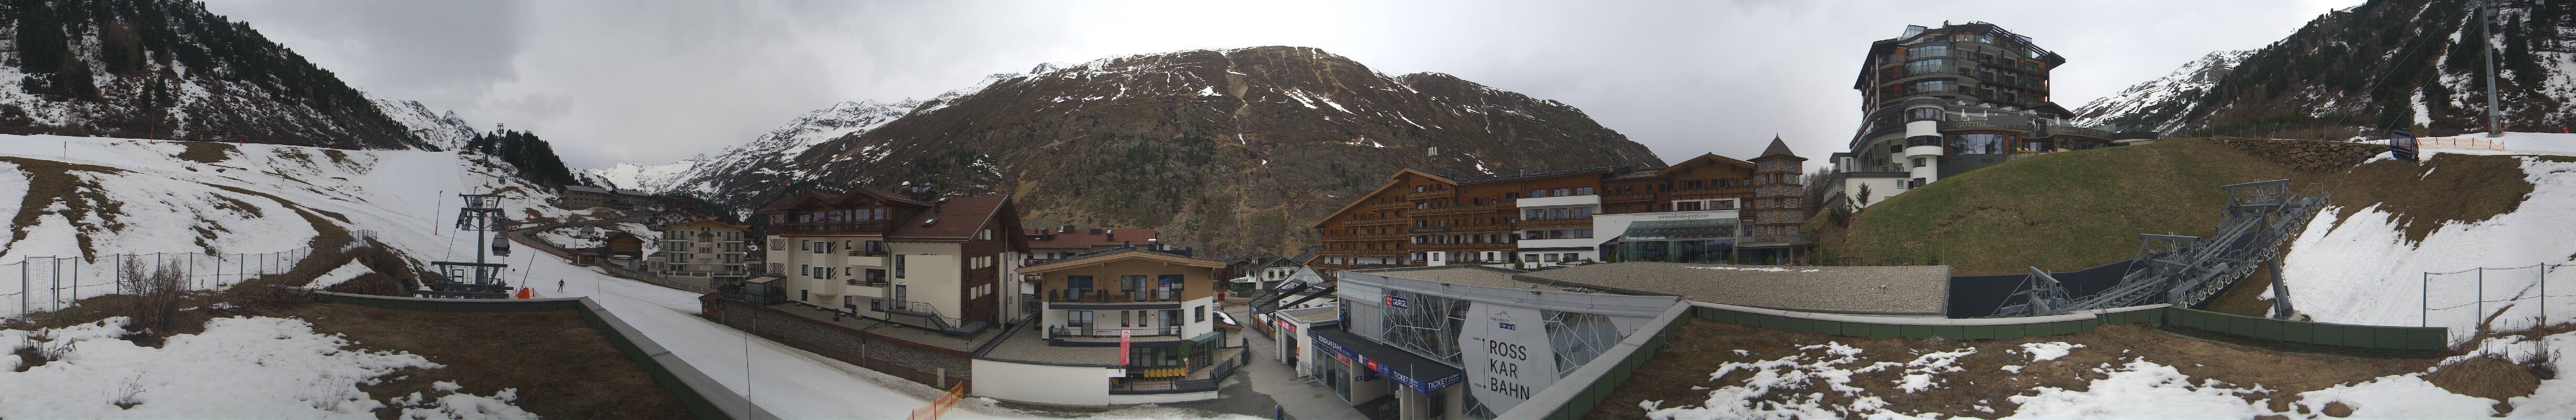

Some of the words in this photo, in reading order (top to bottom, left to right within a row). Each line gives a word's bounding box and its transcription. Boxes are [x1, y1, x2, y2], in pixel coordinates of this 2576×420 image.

[1393, 299, 1407, 308] GURGL
[1319, 335, 1342, 352] ROSSKARBAHN
[1490, 340, 1526, 361] ROSS
[1393, 371, 1408, 383] TICKET
[1490, 358, 1518, 379] KAR
[1427, 377, 1448, 390] TICKET
[1491, 376, 1530, 400] BAHN
